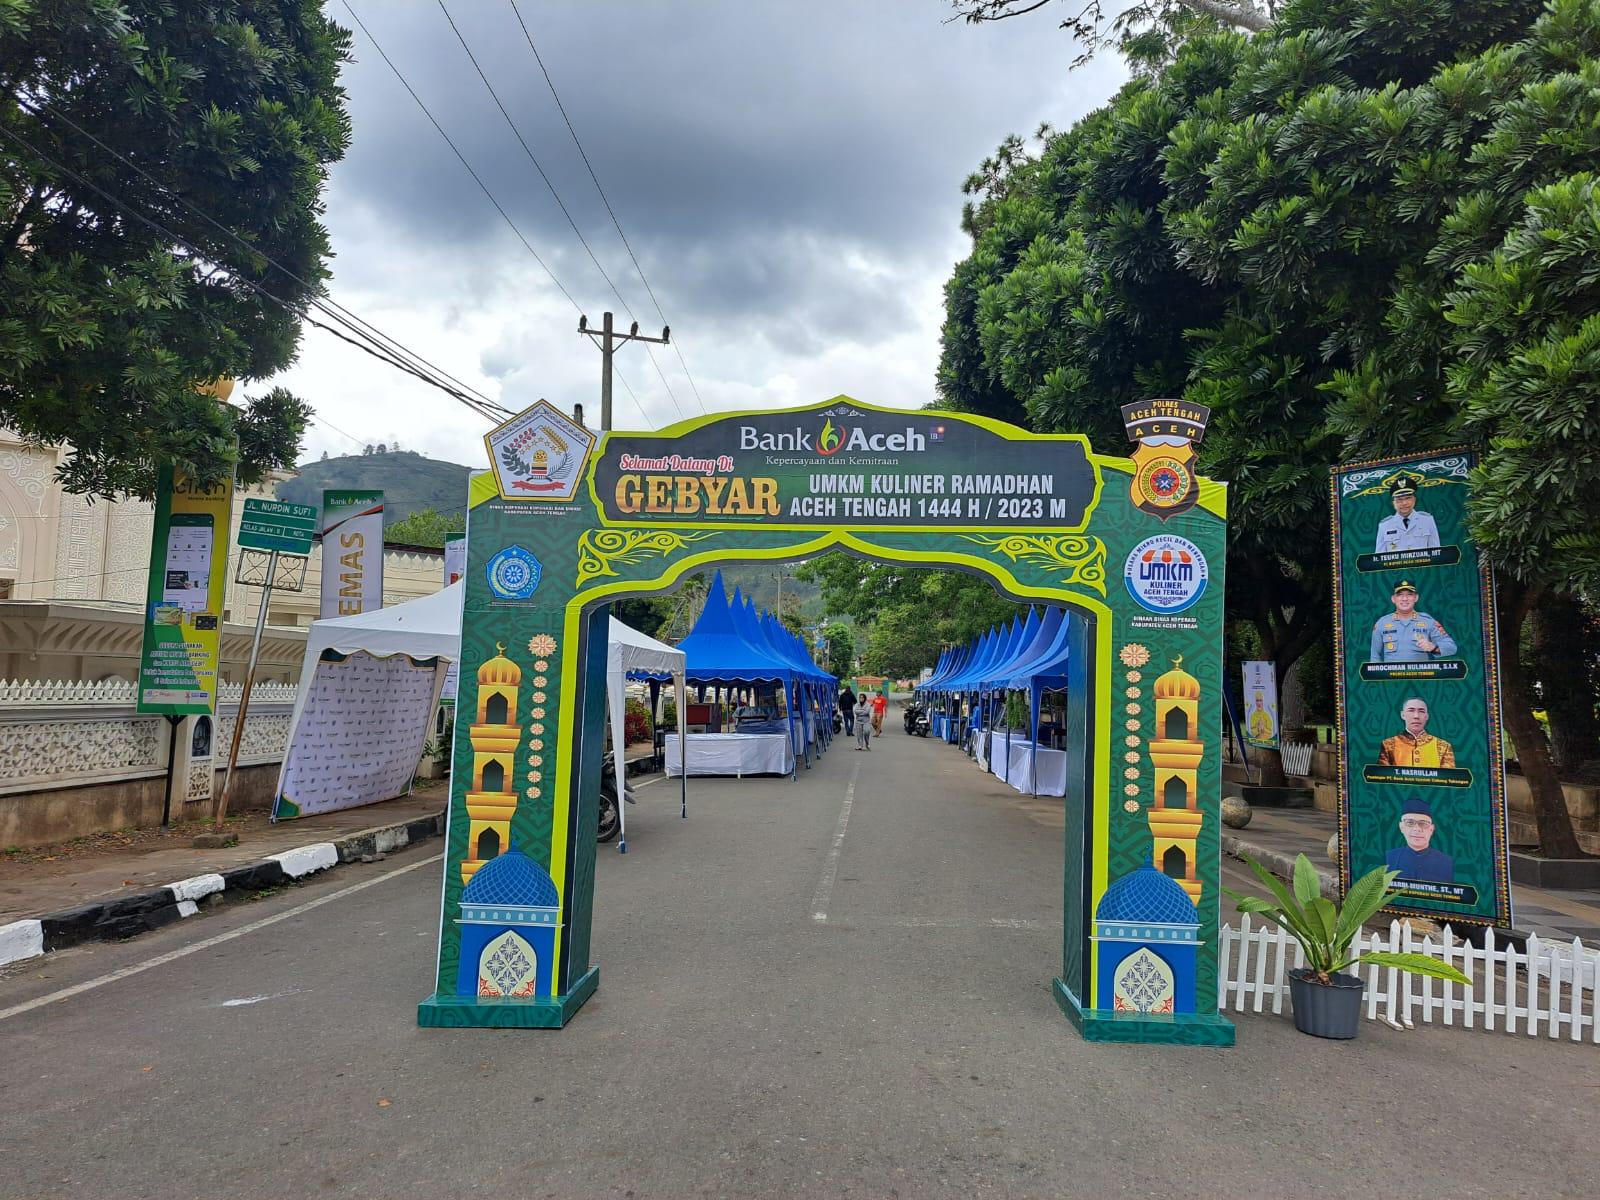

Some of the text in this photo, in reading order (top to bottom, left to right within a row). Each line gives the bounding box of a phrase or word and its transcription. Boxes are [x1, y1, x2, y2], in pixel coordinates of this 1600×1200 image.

[1130, 407, 1201, 421] ACEH TENGAH
[740, 426, 812, 450] Bank
[847, 427, 926, 451] Aceh
[1135, 424, 1196, 437] ACEH
[620, 453, 734, 476] Selamat Datang Di
[766, 455, 899, 466] Kepercayaan dan Kemitraan
[809, 474, 1053, 495] UMKM KULINER RAMADHAN
[615, 474, 781, 516] GEBYAR
[261, 502, 291, 514] NURDIN
[292, 506, 312, 517] SUFI
[790, 497, 1066, 520] ACEH TENGAH 1444 H / 2023 M
[338, 532, 364, 616] EMAS
[1139, 562, 1193, 581] UMKM
[1143, 588, 1161, 596] ACEH
[1149, 581, 1183, 590] KULINER
[1453, 887, 1465, 895] MT
